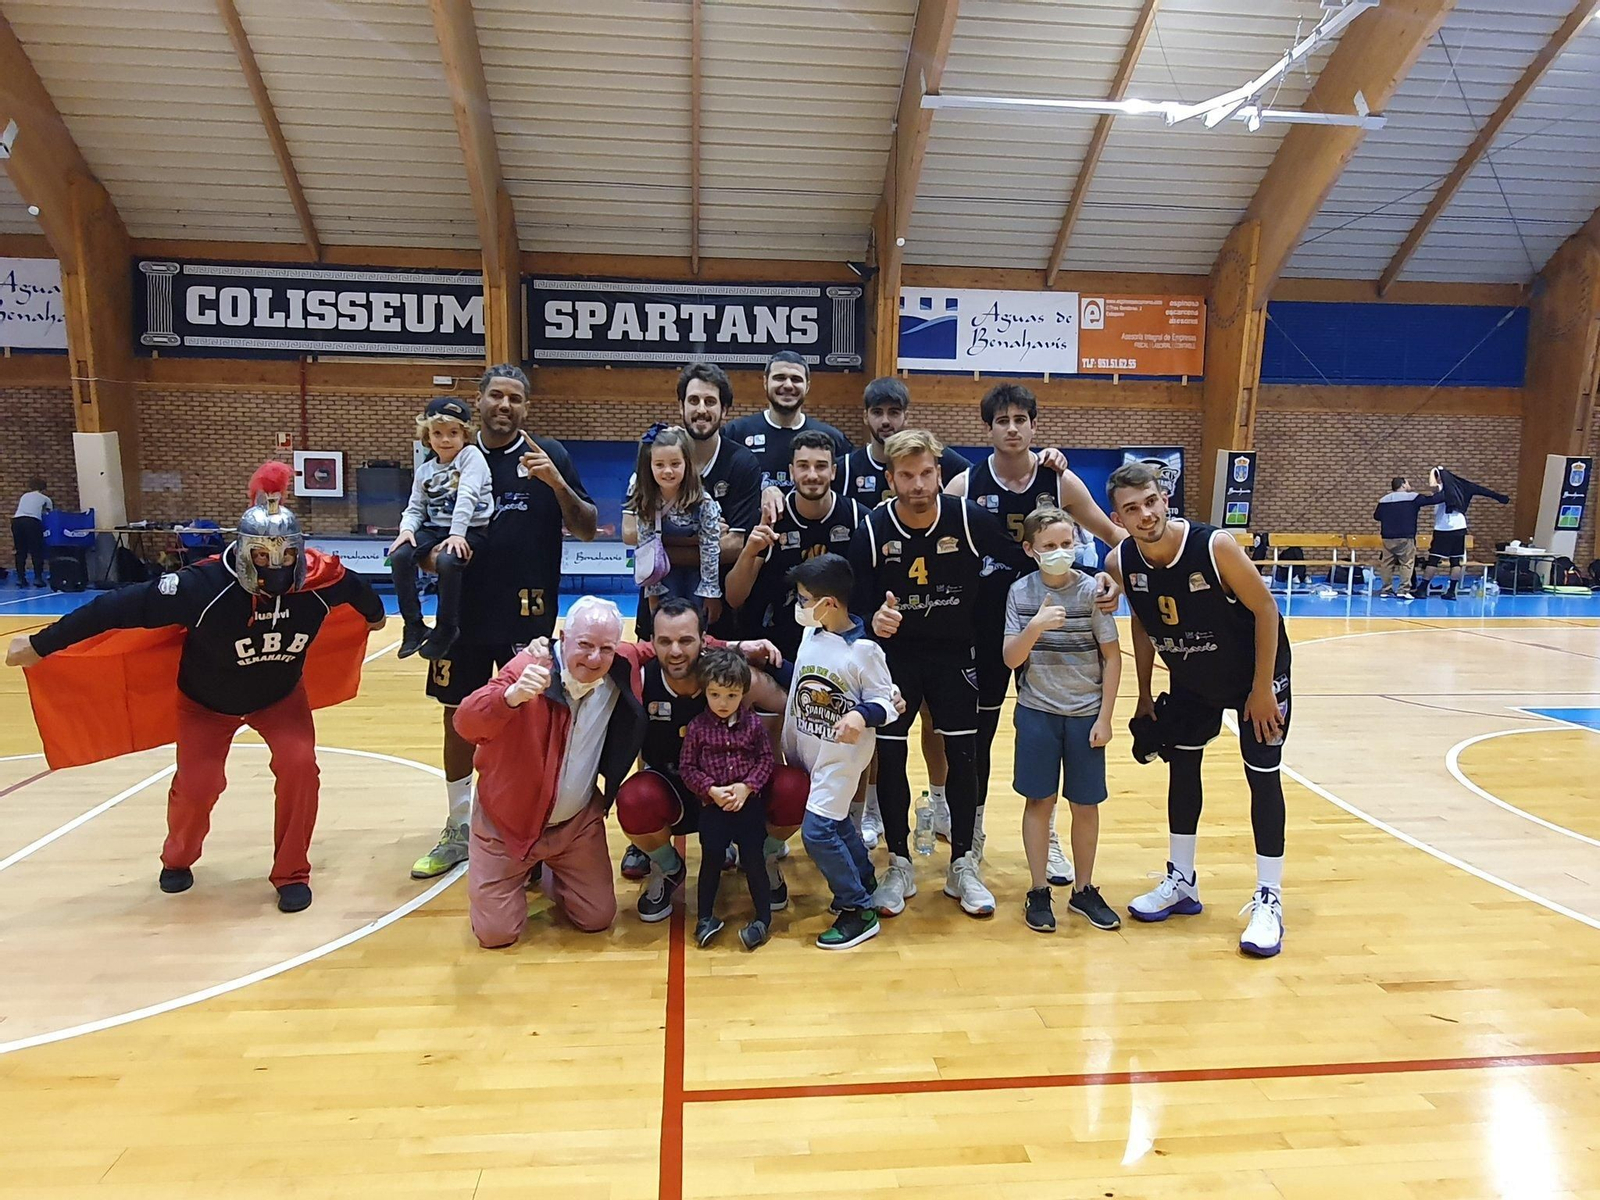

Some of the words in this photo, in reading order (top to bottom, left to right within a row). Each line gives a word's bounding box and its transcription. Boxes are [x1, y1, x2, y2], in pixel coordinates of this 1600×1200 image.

[0, 270, 61, 305] Agua
[185, 286, 485, 334] COLISSEUM
[544, 300, 819, 344] SPARTANS
[971, 301, 1044, 333] Aguas
[1056, 312, 1072, 323] de
[1007, 513, 1024, 543] 5
[908, 556, 929, 585] 4
[518, 588, 545, 616] 13
[1158, 595, 1179, 625] 9
